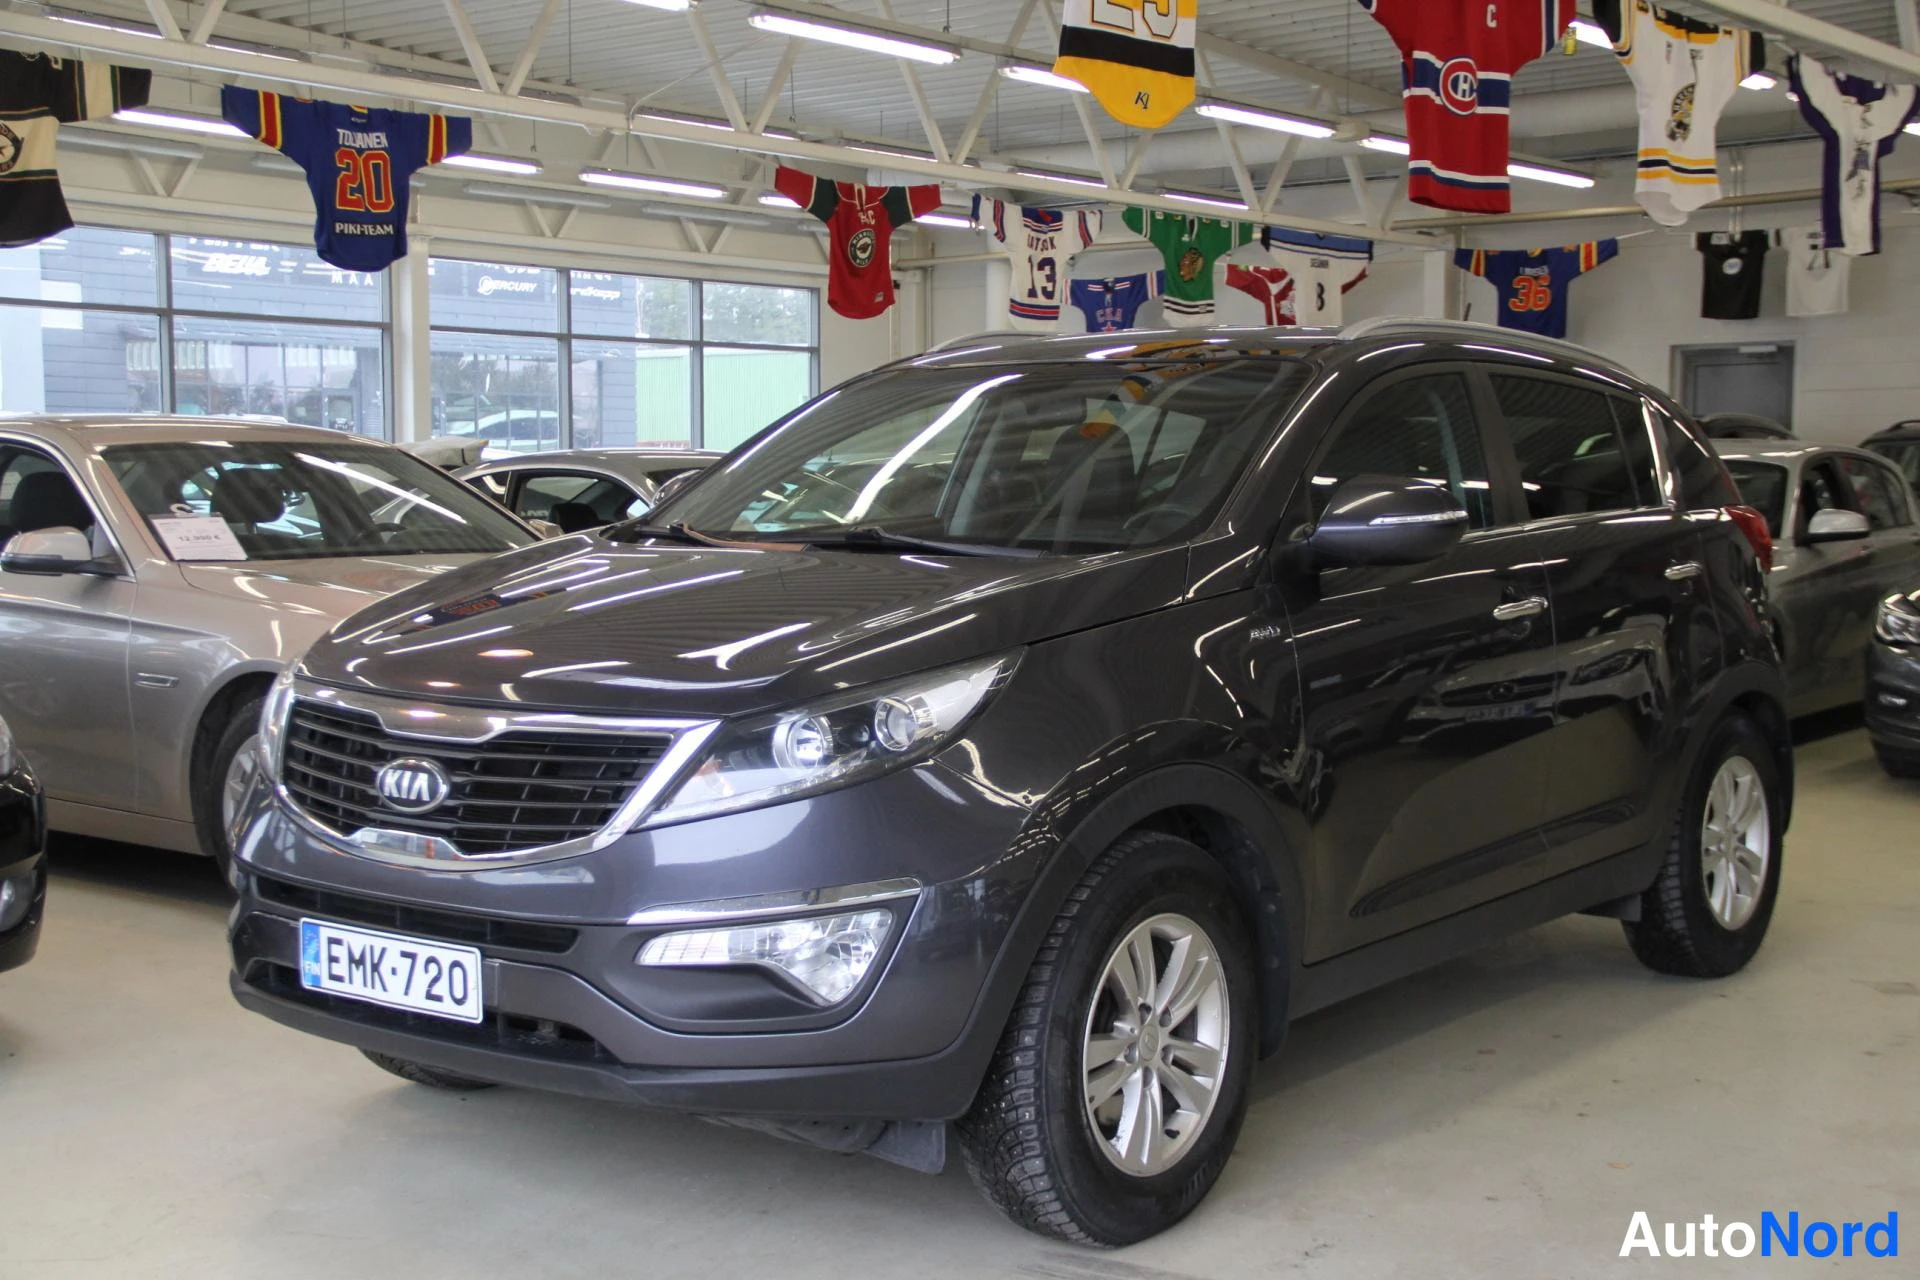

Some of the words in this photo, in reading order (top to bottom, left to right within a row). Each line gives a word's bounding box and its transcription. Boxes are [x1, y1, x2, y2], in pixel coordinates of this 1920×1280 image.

[1486, 4, 1497, 28] C
[335, 147, 395, 213] 20
[335, 222, 394, 236] PIKI-TEAM
[1027, 254, 1056, 300] 13
[1508, 275, 1552, 312] 36
[383, 768, 430, 802] KIA
